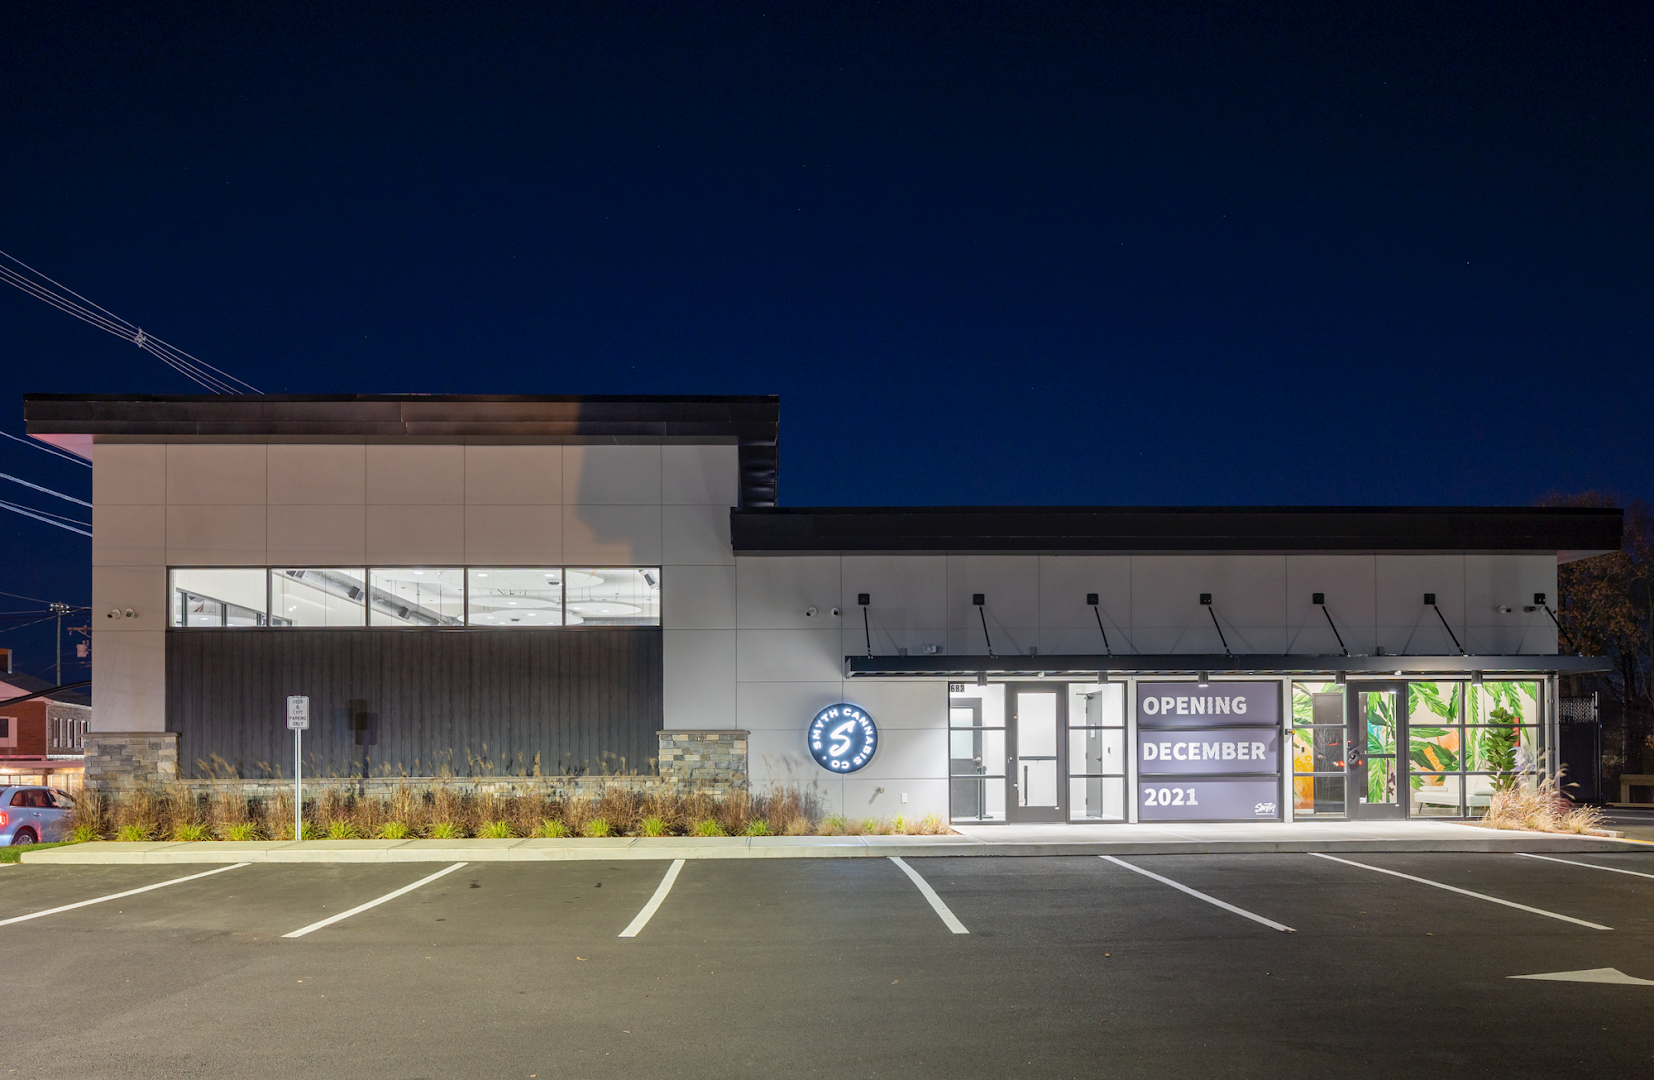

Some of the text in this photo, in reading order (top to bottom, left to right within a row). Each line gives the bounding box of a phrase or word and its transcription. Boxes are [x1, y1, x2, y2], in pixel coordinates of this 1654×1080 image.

[950, 684, 965, 693] 683
[1143, 696, 1247, 715] OPENING
[812, 708, 839, 750] SMYTH
[842, 707, 874, 765] CANNABIS
[829, 720, 856, 757] S
[1143, 742, 1266, 760] DECEMBER
[1144, 788, 1198, 806] 2021
